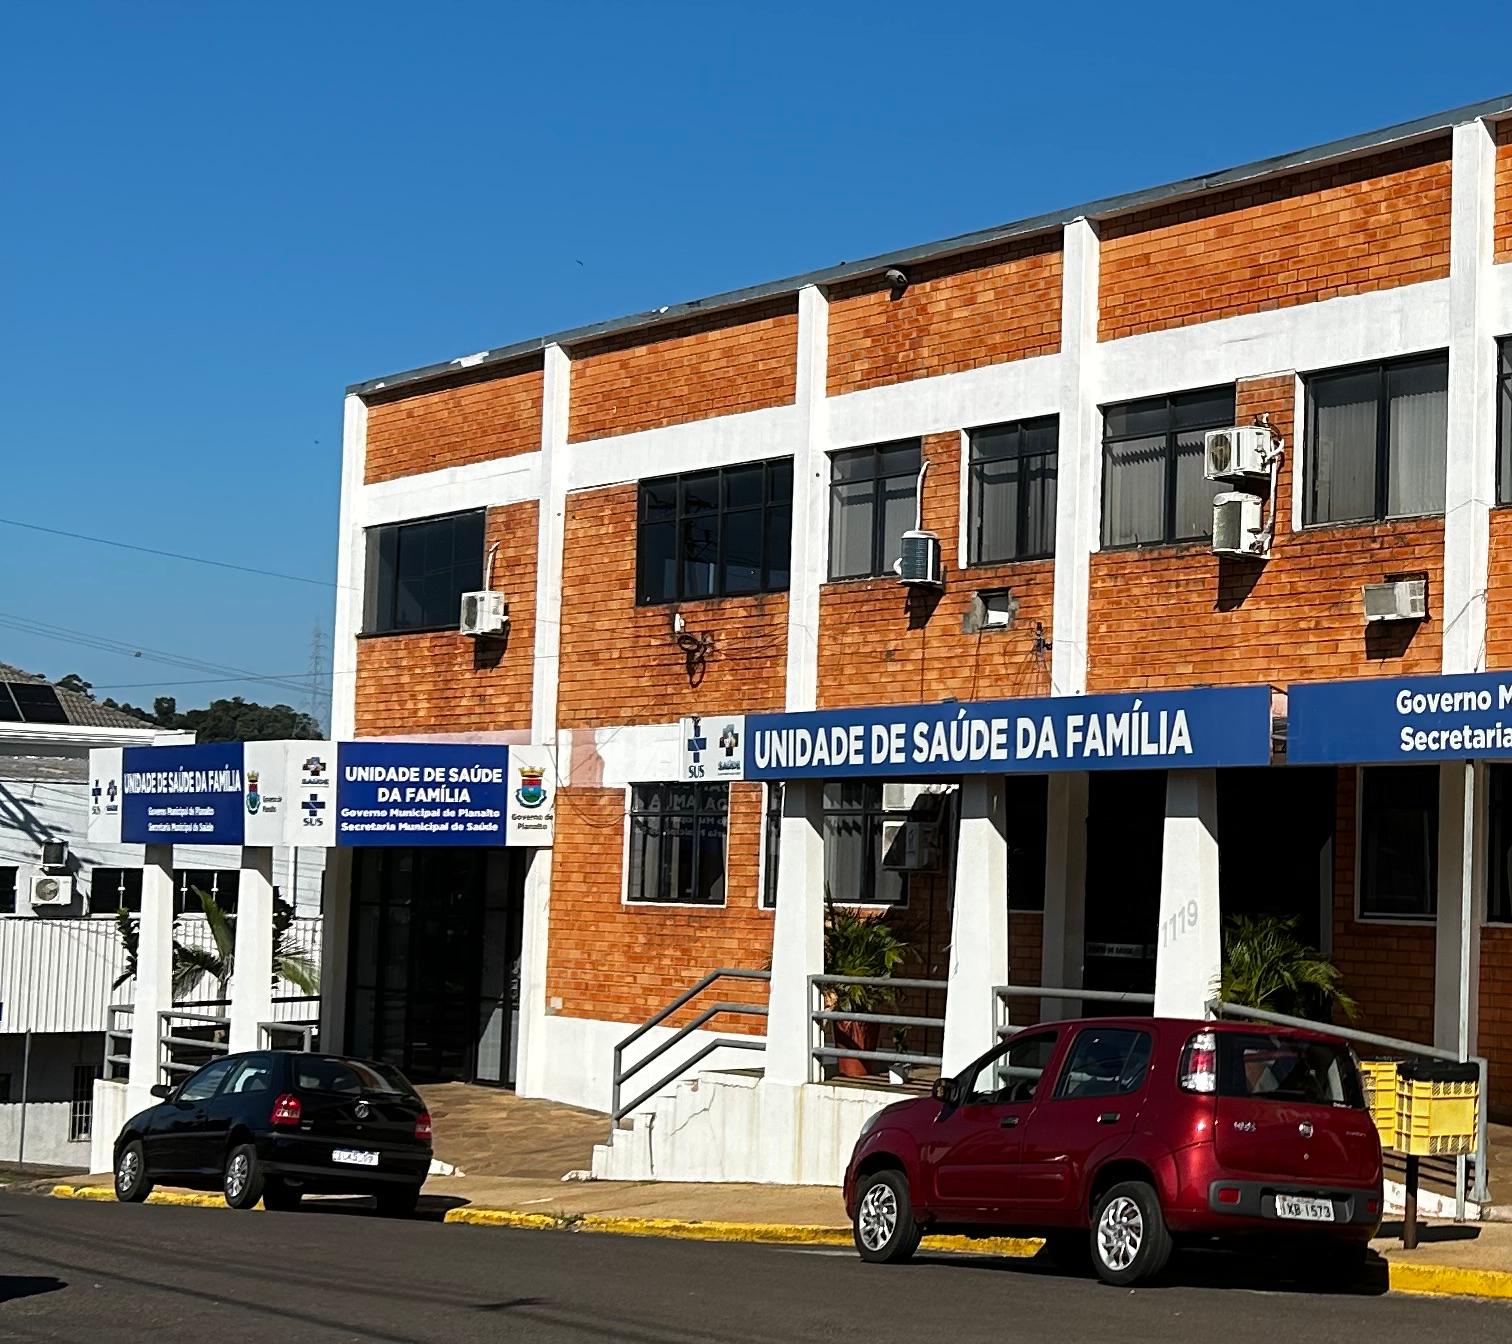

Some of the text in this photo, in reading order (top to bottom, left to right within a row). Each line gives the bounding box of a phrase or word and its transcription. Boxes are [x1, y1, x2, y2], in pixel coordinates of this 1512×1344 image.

[1396, 689, 1492, 715] Governo
[755, 699, 1193, 769] UNIDADE DE SAÚDE DA FAMÍLIA
[123, 764, 242, 794] UNIDADE DE SAÚDE DA FAMÍLIA
[345, 764, 503, 783] UNIDADE DE SAÚDE
[688, 764, 705, 778] SUS
[377, 784, 471, 803] DA FAMÍLIA
[303, 817, 324, 827] SUS
[340, 807, 501, 819] Governo Municipal de Planalto
[340, 821, 499, 833] Secretaria Municipal de Saúde
[1161, 899, 1199, 948] 1119
